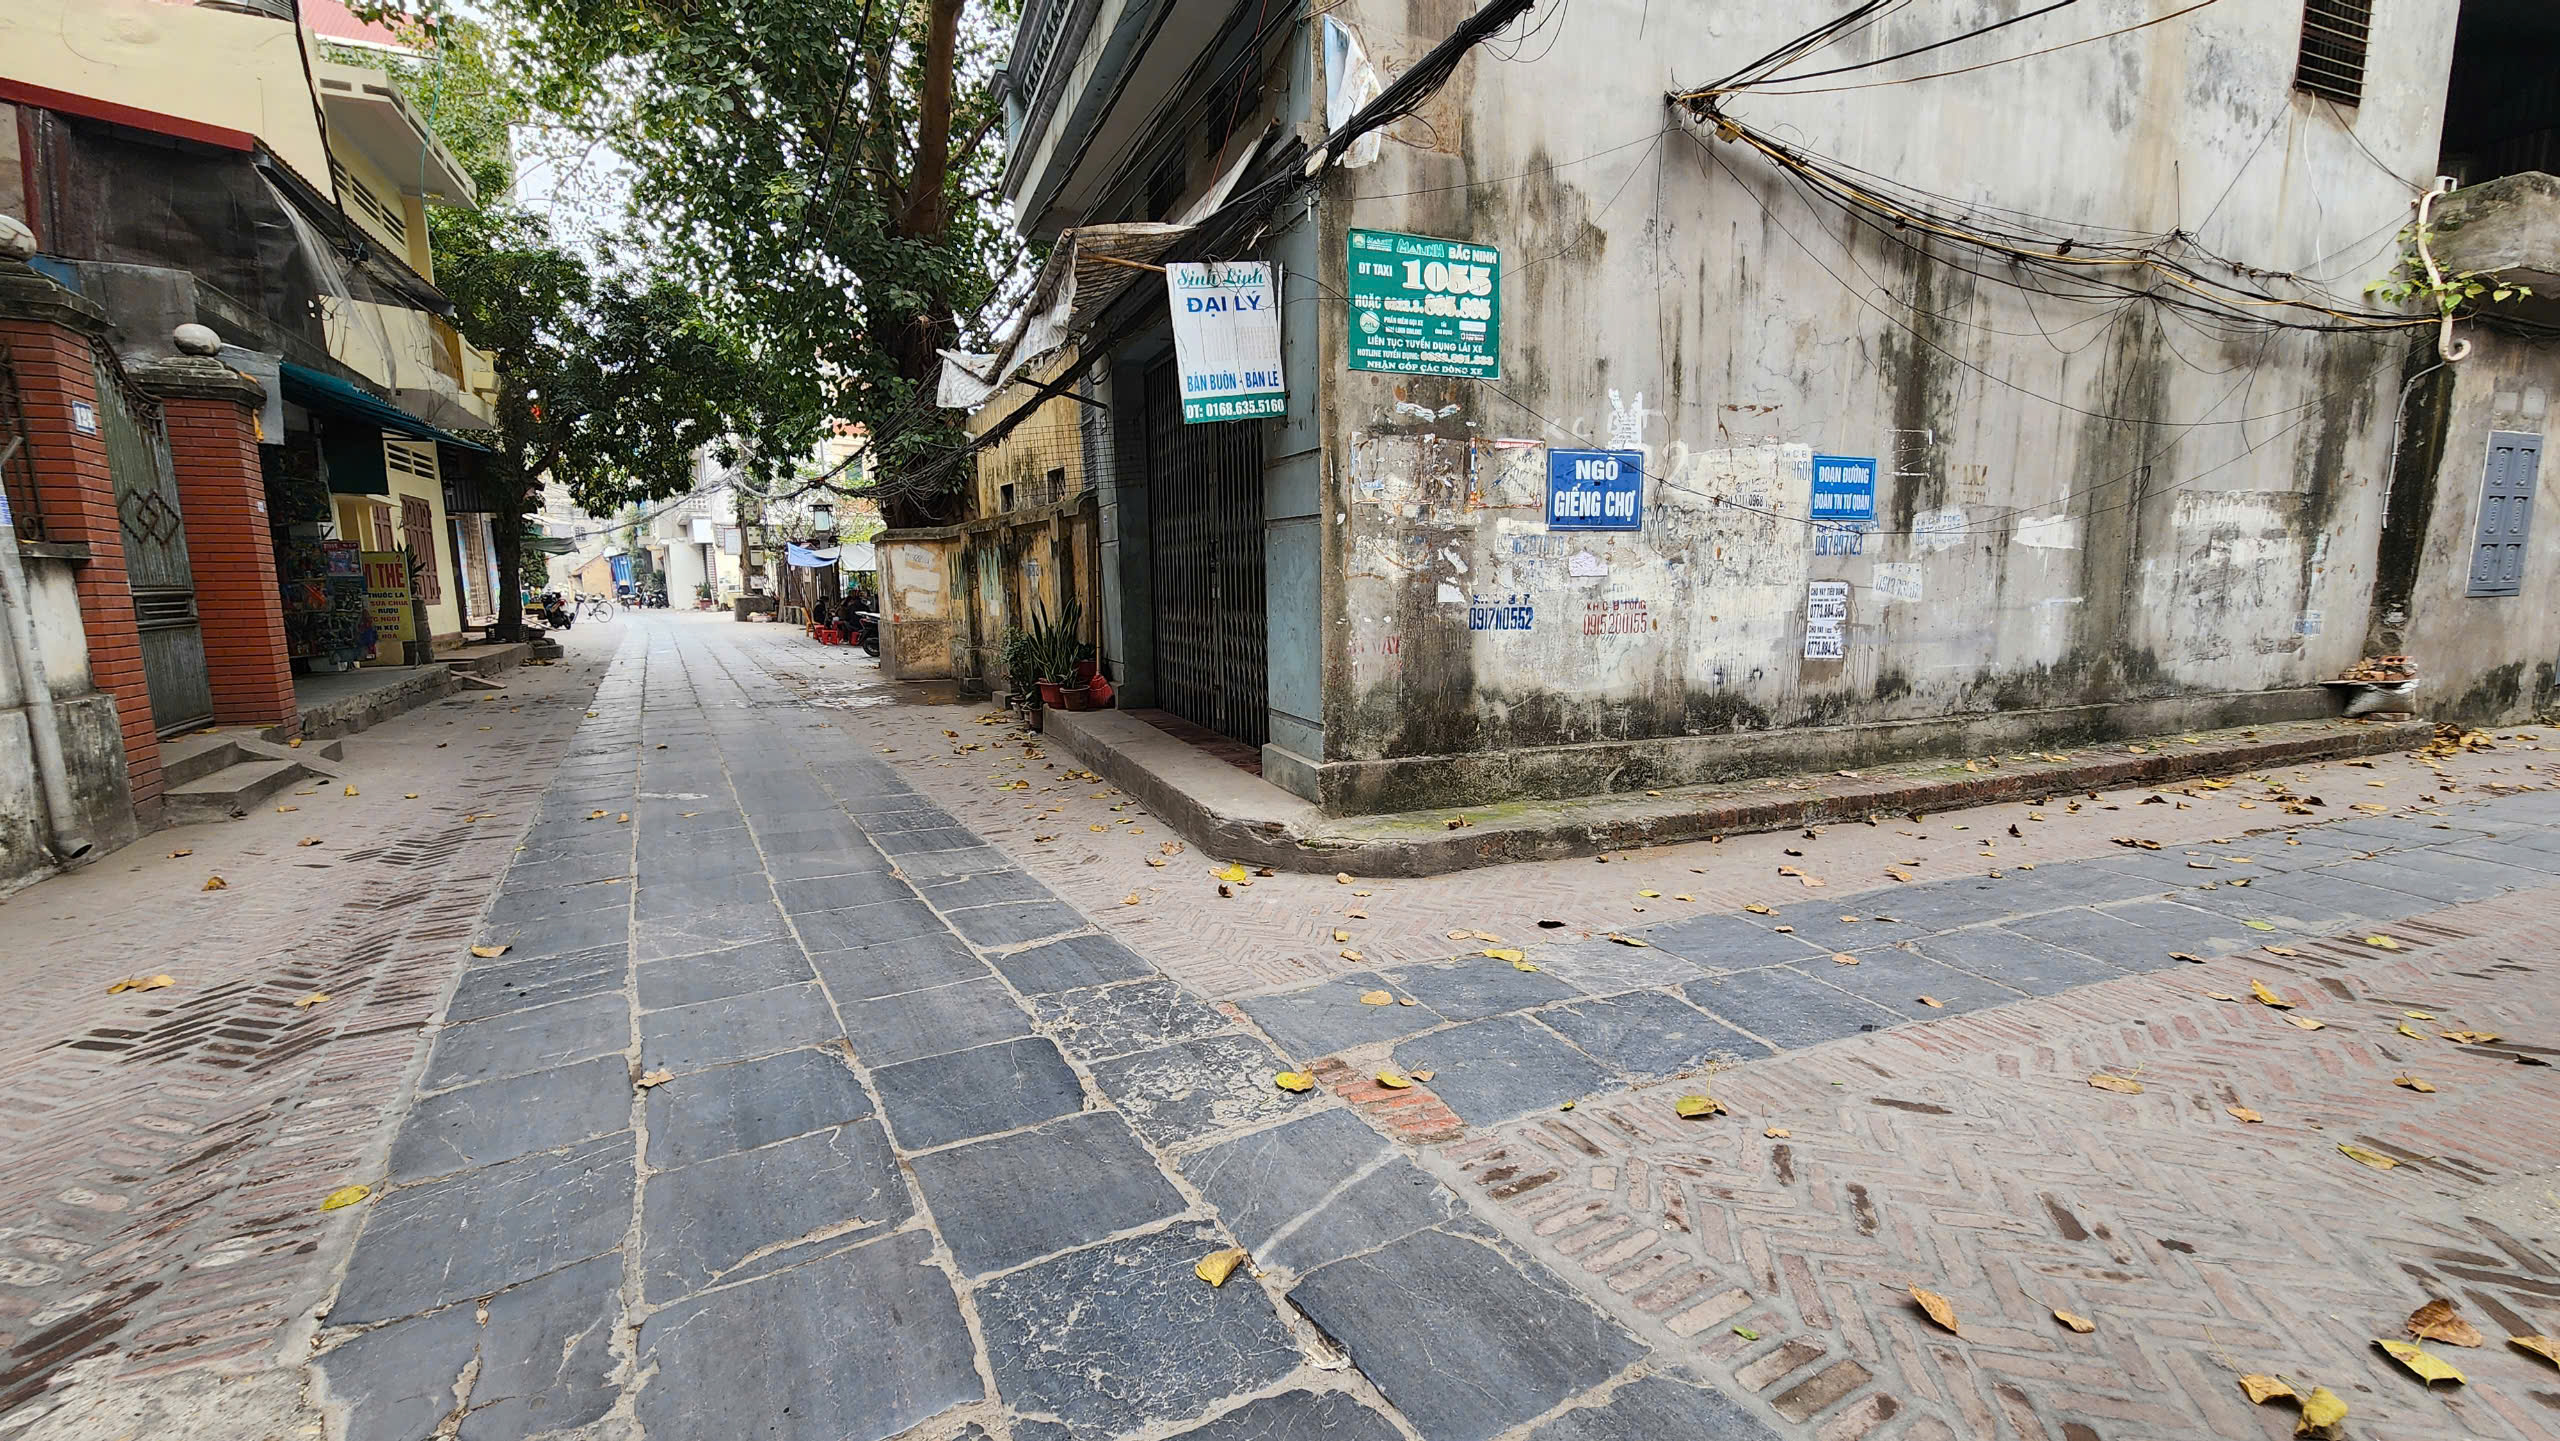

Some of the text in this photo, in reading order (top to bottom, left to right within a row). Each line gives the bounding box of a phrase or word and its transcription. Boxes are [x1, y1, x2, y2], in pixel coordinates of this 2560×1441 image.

[1472, 249, 1498, 264] NINH
[1373, 263, 1393, 277] TAXI
[1402, 258, 1492, 296] 1055
[1186, 290, 1262, 318] ĐẠI LÝ
[1354, 293, 1382, 312] HOẶC
[1357, 348, 1382, 358] HOTLINE
[1367, 335, 1483, 354] LIÊN TỤC TUYỂN DỤNG LÁI XE
[1186, 371, 1208, 393] BÁN
[1209, 369, 1237, 391] BUÔN
[1244, 368, 1266, 389] BÁN
[1267, 363, 1280, 387] LẺ
[1366, 359, 1396, 371] NHẬN
[1397, 360, 1419, 371] GÓP
[1420, 362, 1440, 373] CÁC
[1470, 367, 1483, 376] XE
[1205, 398, 1285, 417] 0168.635.5160
[1575, 456, 1619, 481] NGÕ
[1818, 465, 1841, 486] ĐOẠN
[1842, 463, 1870, 484] ĐƯỜNG
[1554, 483, 1636, 522] GIẾNG CHỢ
[1813, 490, 1833, 510] ĐOÀN
[1843, 493, 1853, 513] TỰ
[375, 554, 405, 589] THẺ
[1468, 606, 1534, 632] 0917110552
